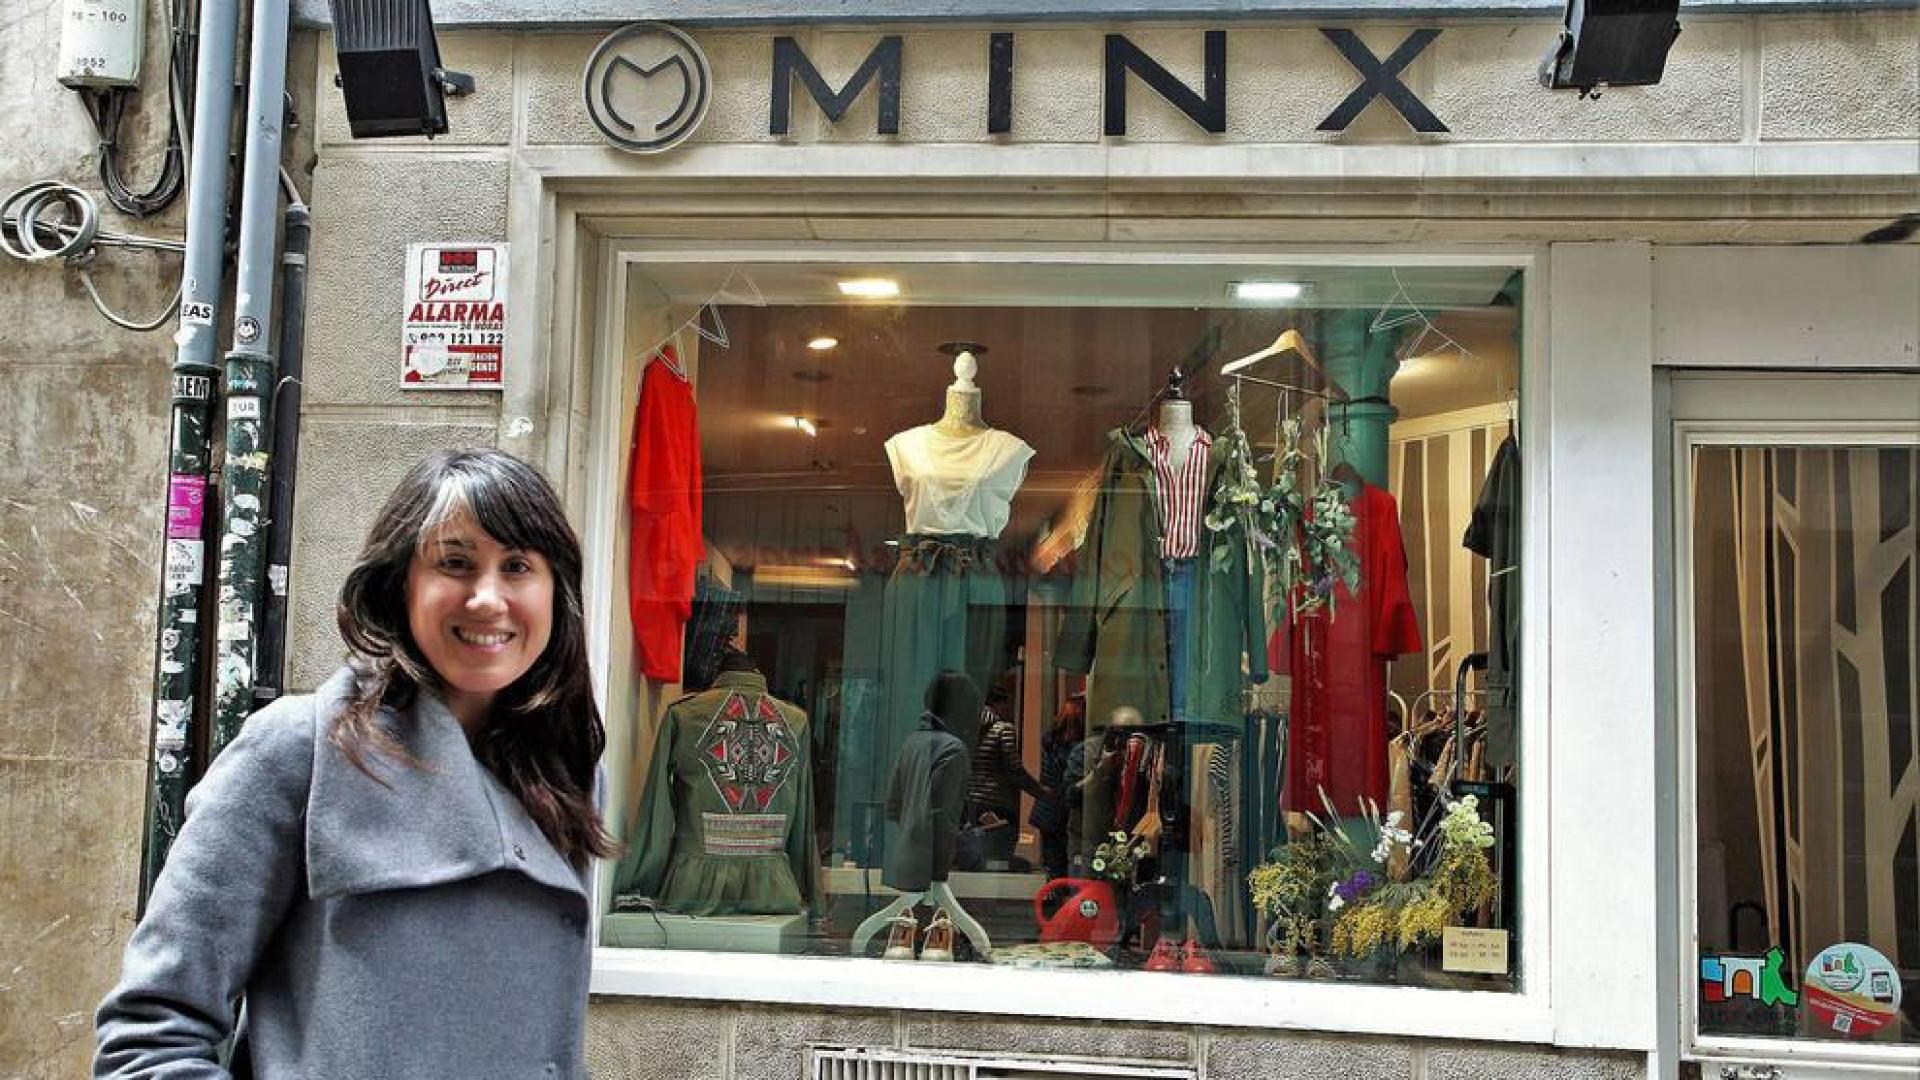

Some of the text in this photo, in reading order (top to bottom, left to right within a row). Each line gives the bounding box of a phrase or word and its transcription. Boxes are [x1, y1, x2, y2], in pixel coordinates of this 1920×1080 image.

[769, 27, 1451, 137] MINX
[424, 271, 491, 299] Direct
[408, 302, 504, 322] ALARMA
[451, 332, 472, 344] 121
[480, 332, 503, 344] 122
